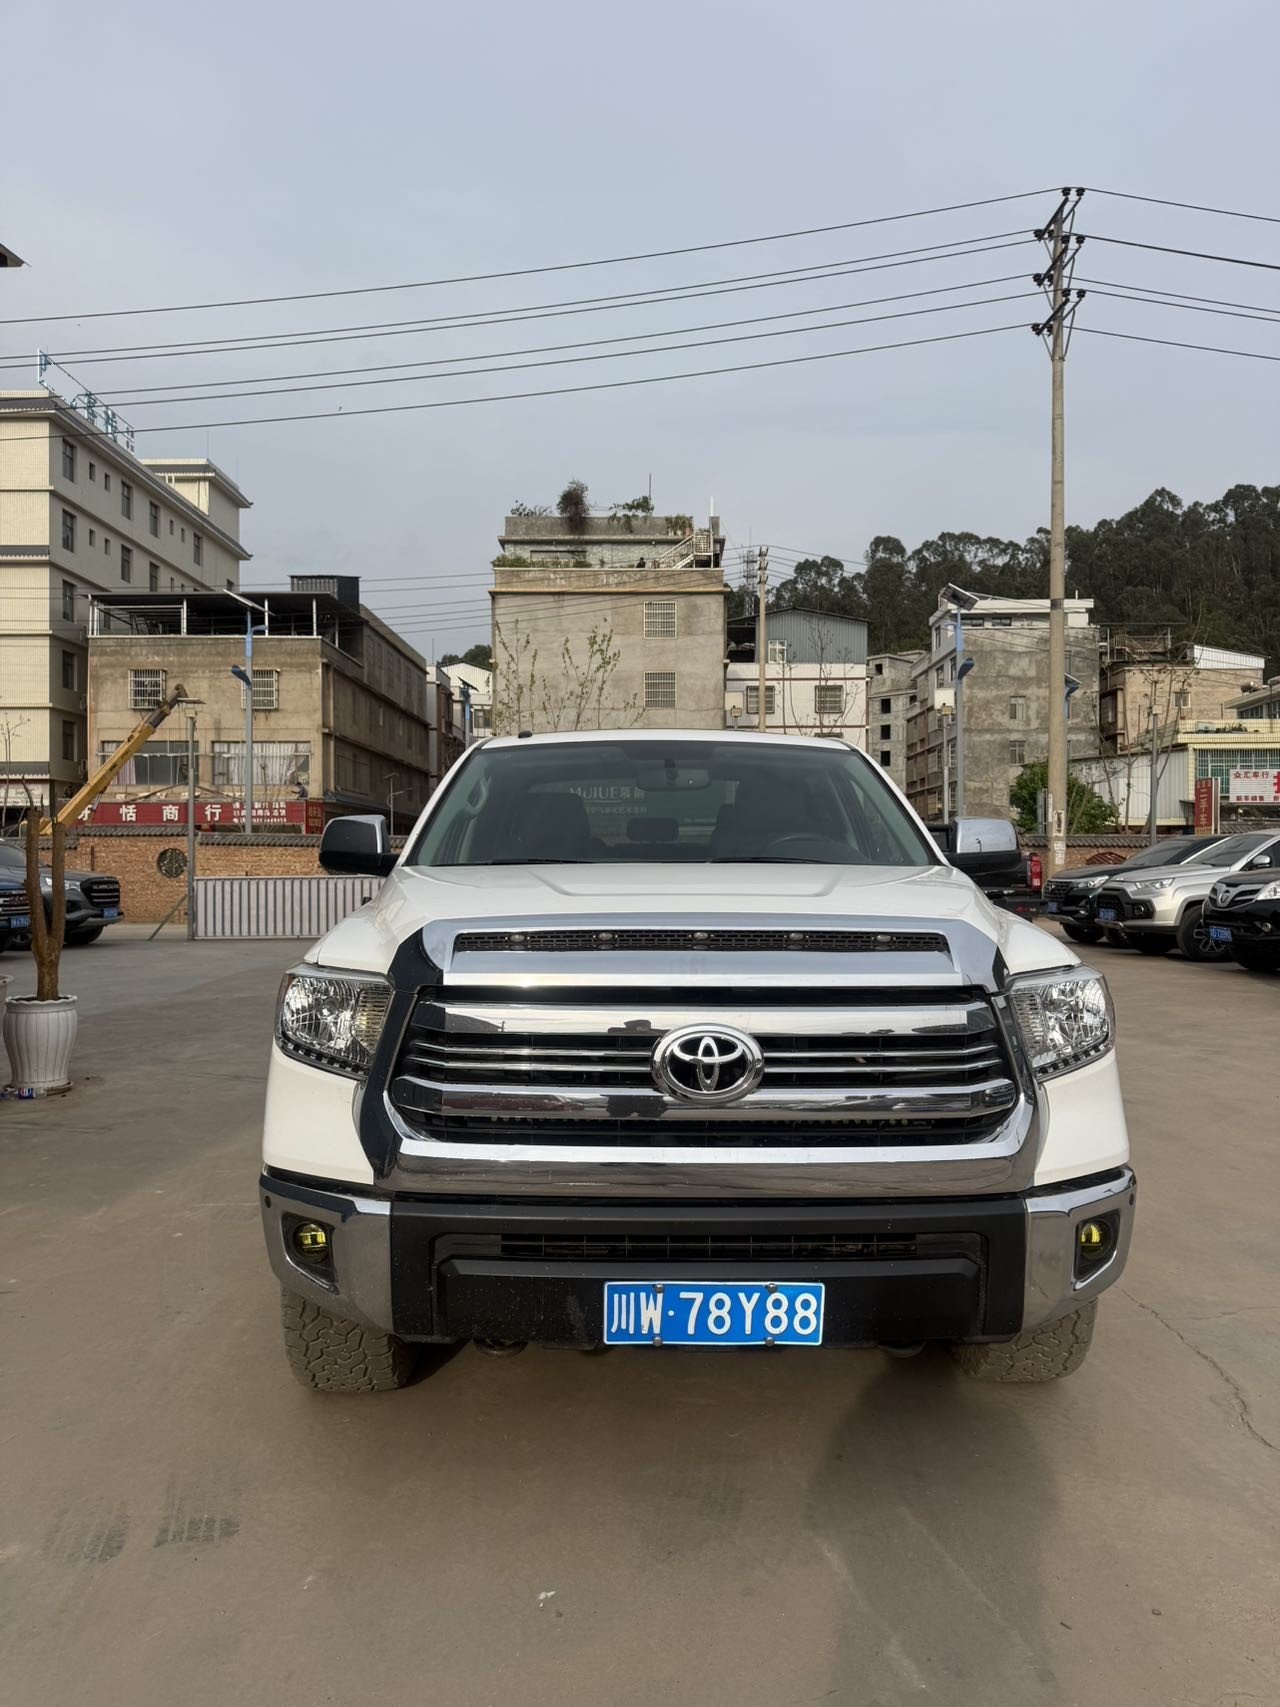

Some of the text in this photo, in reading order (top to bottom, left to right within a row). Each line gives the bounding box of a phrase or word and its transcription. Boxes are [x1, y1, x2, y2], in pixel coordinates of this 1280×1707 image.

[1233, 771, 1270, 779] 众汇车行
[1199, 788, 1208, 827] 二手车
[610, 1291, 818, 1336] 川W·78Y88
